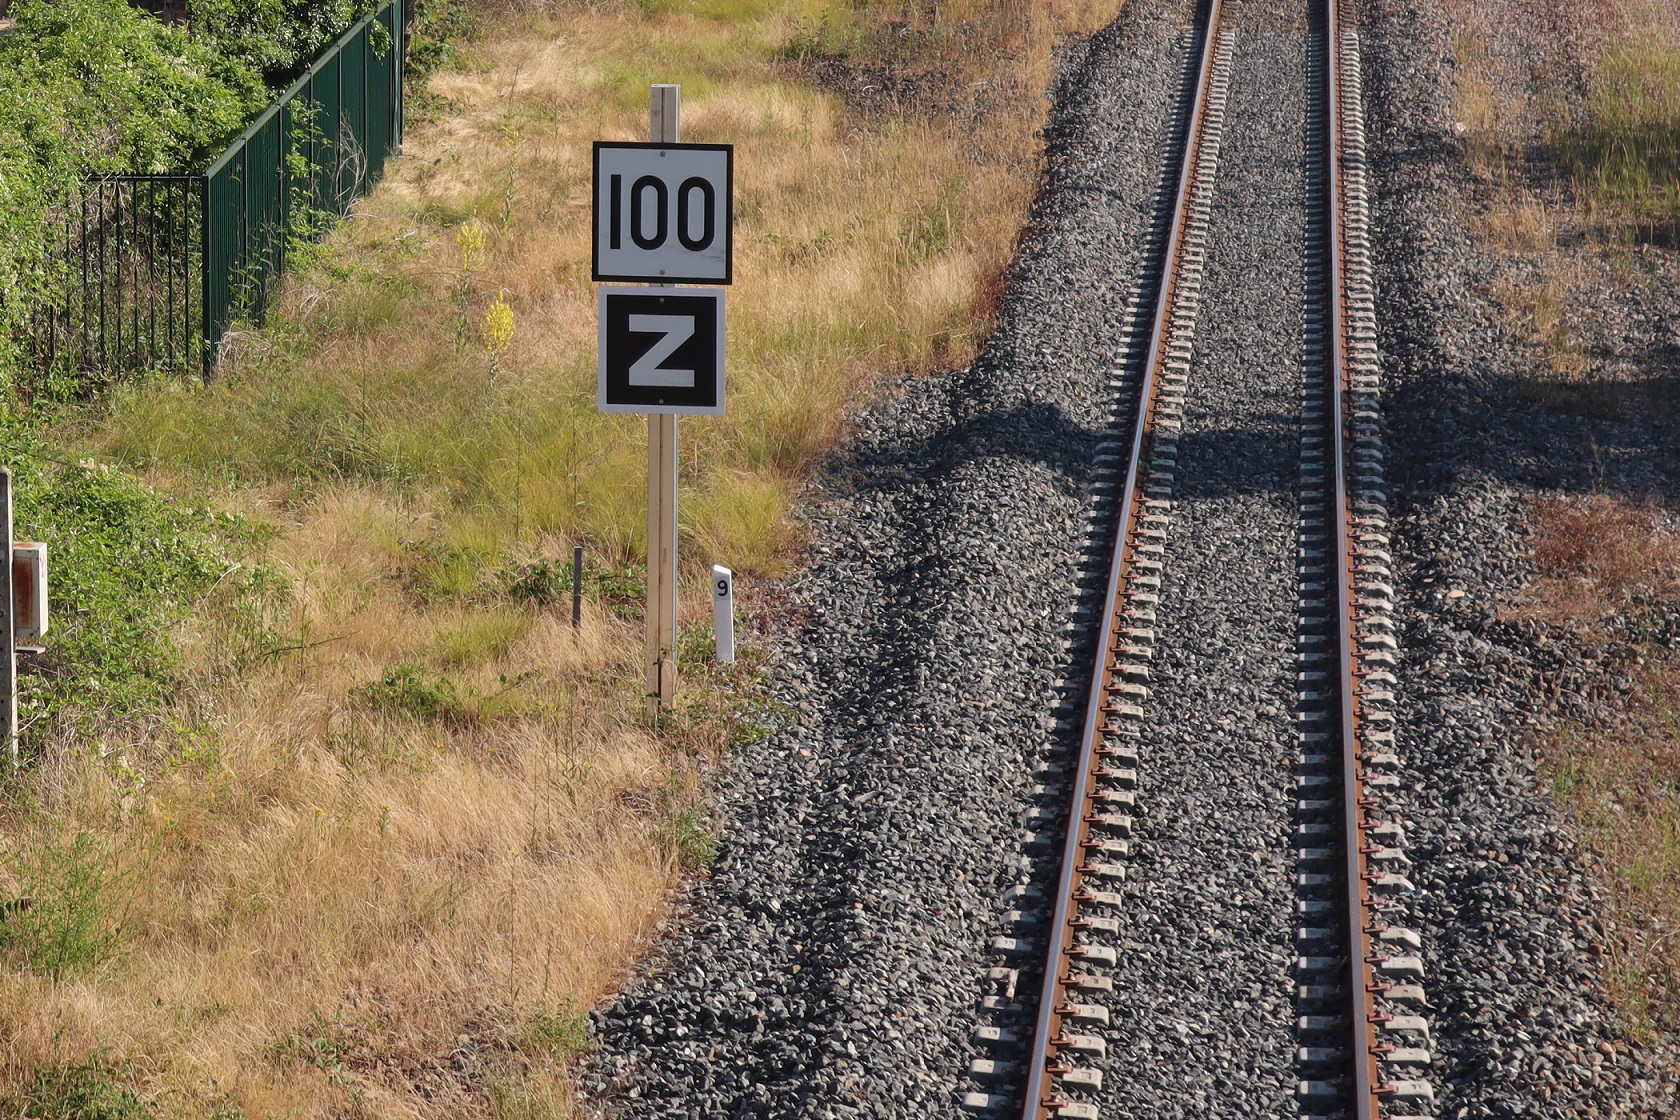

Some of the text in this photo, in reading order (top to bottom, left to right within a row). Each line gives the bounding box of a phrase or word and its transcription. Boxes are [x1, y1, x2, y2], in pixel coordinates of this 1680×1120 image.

[610, 173, 715, 251] 100
[628, 313, 695, 387] Z
[717, 579, 728, 597] 9
